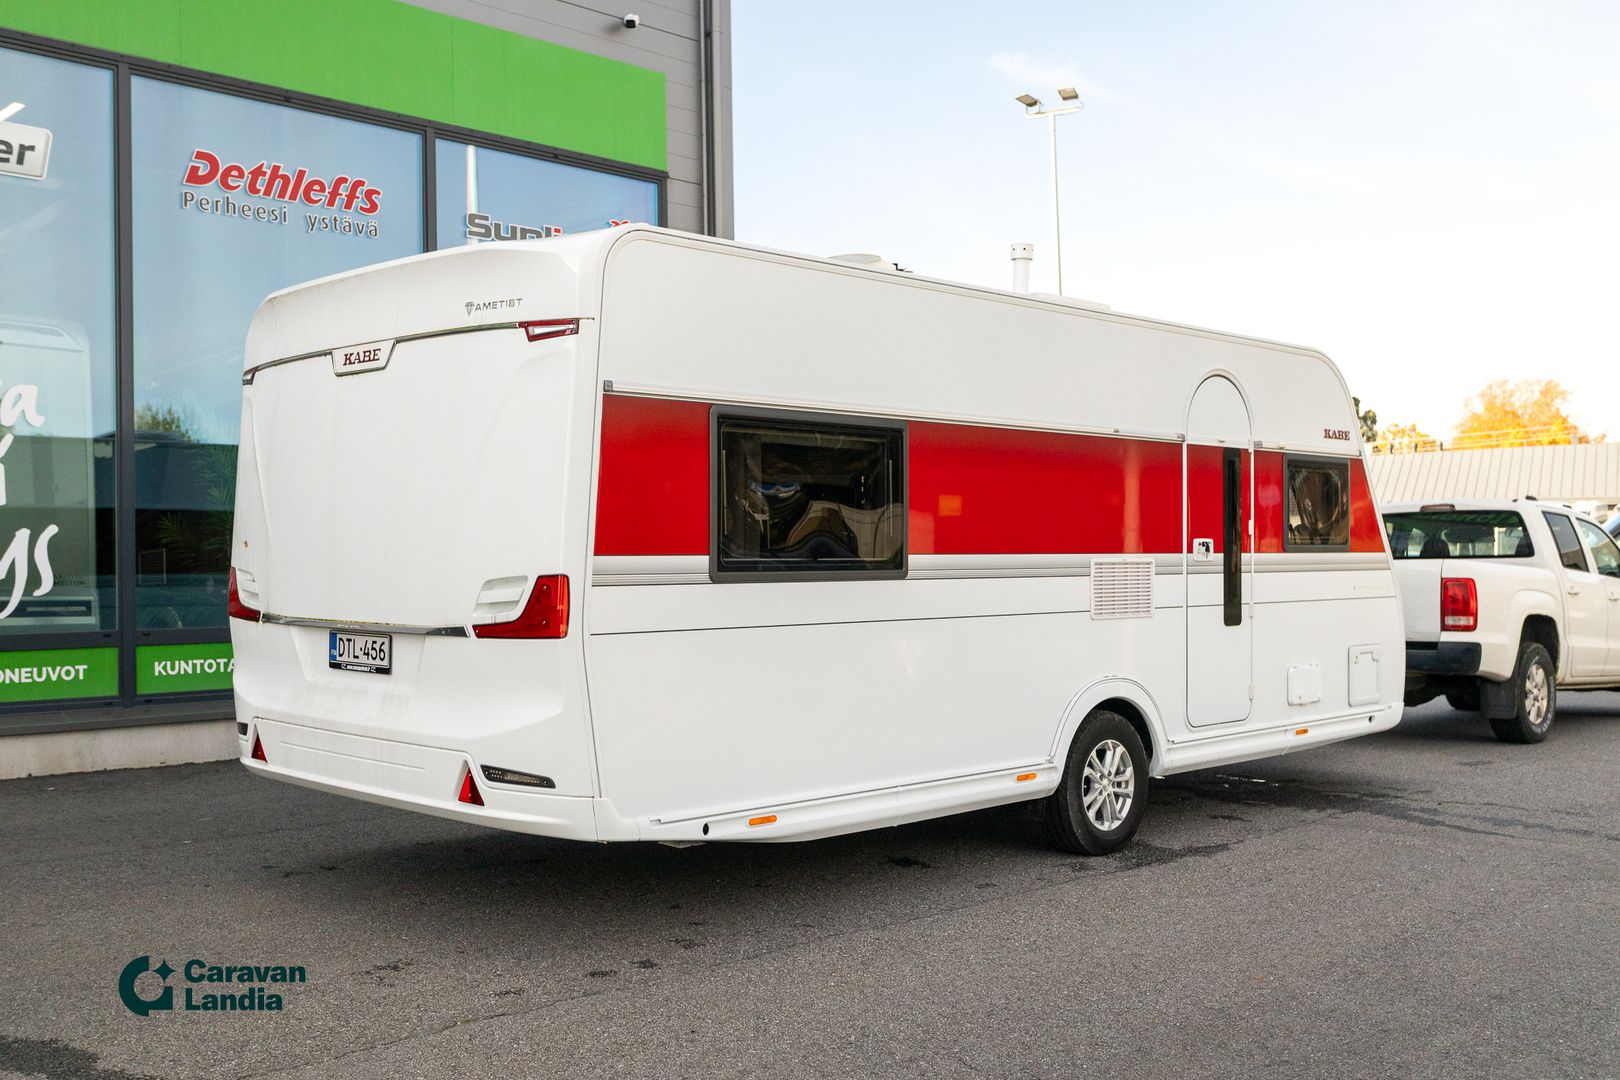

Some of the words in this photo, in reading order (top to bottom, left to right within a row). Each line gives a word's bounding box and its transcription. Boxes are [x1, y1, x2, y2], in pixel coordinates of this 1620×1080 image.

[184, 149, 382, 215] Dethleffs
[183, 191, 288, 224] Perheesi
[307, 214, 379, 238] ystävä
[474, 298, 523, 312] AMETIST
[343, 348, 381, 366] KABE
[1323, 428, 1350, 441] KABE
